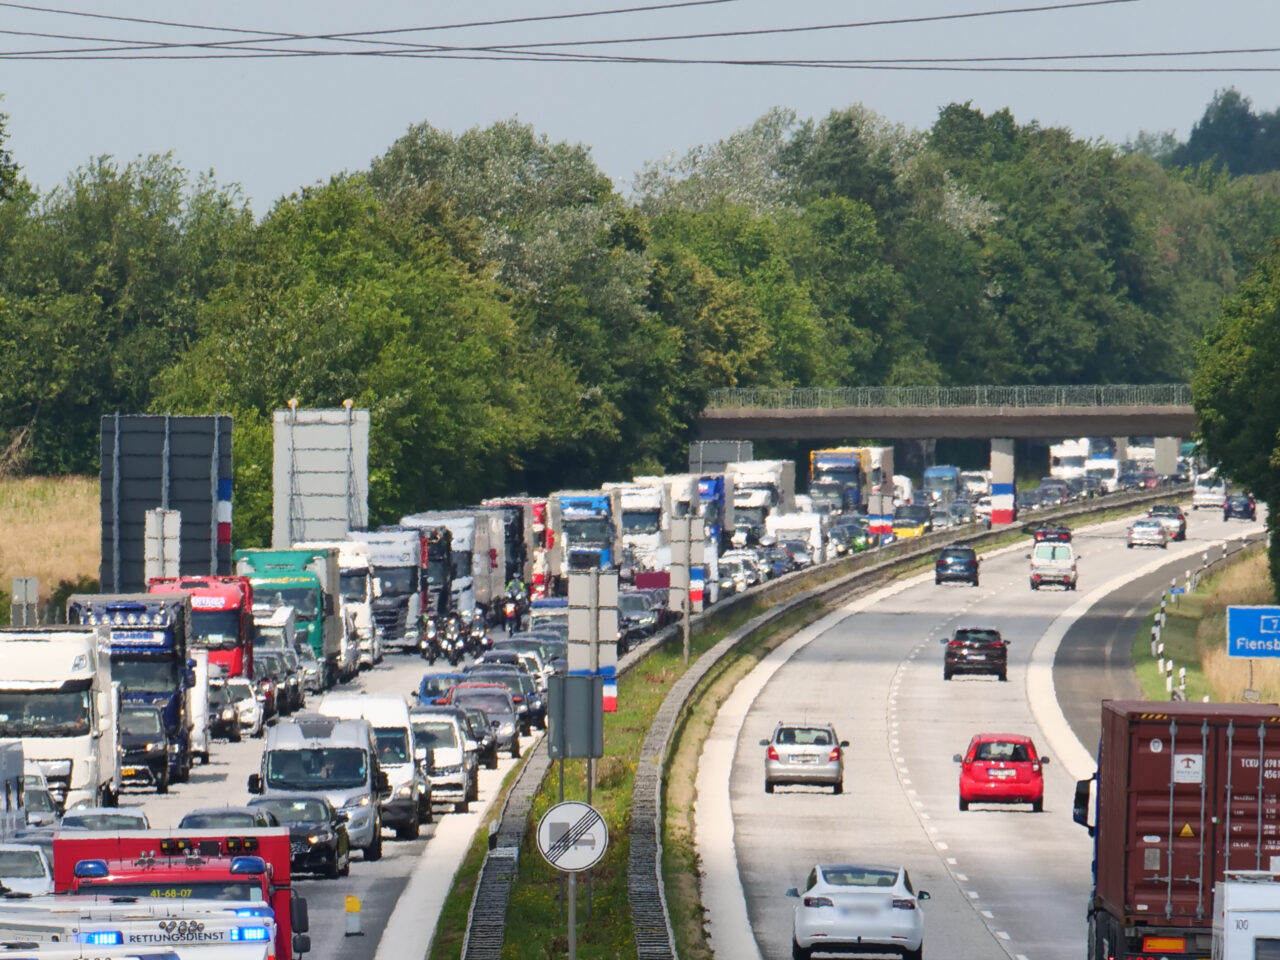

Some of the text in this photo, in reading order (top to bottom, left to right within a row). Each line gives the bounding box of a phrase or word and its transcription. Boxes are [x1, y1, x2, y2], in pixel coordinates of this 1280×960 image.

[1271, 619, 1279, 631] 7
[150, 889, 192, 898] 41-68-07
[129, 931, 225, 943] RETTUNGSDIENST
